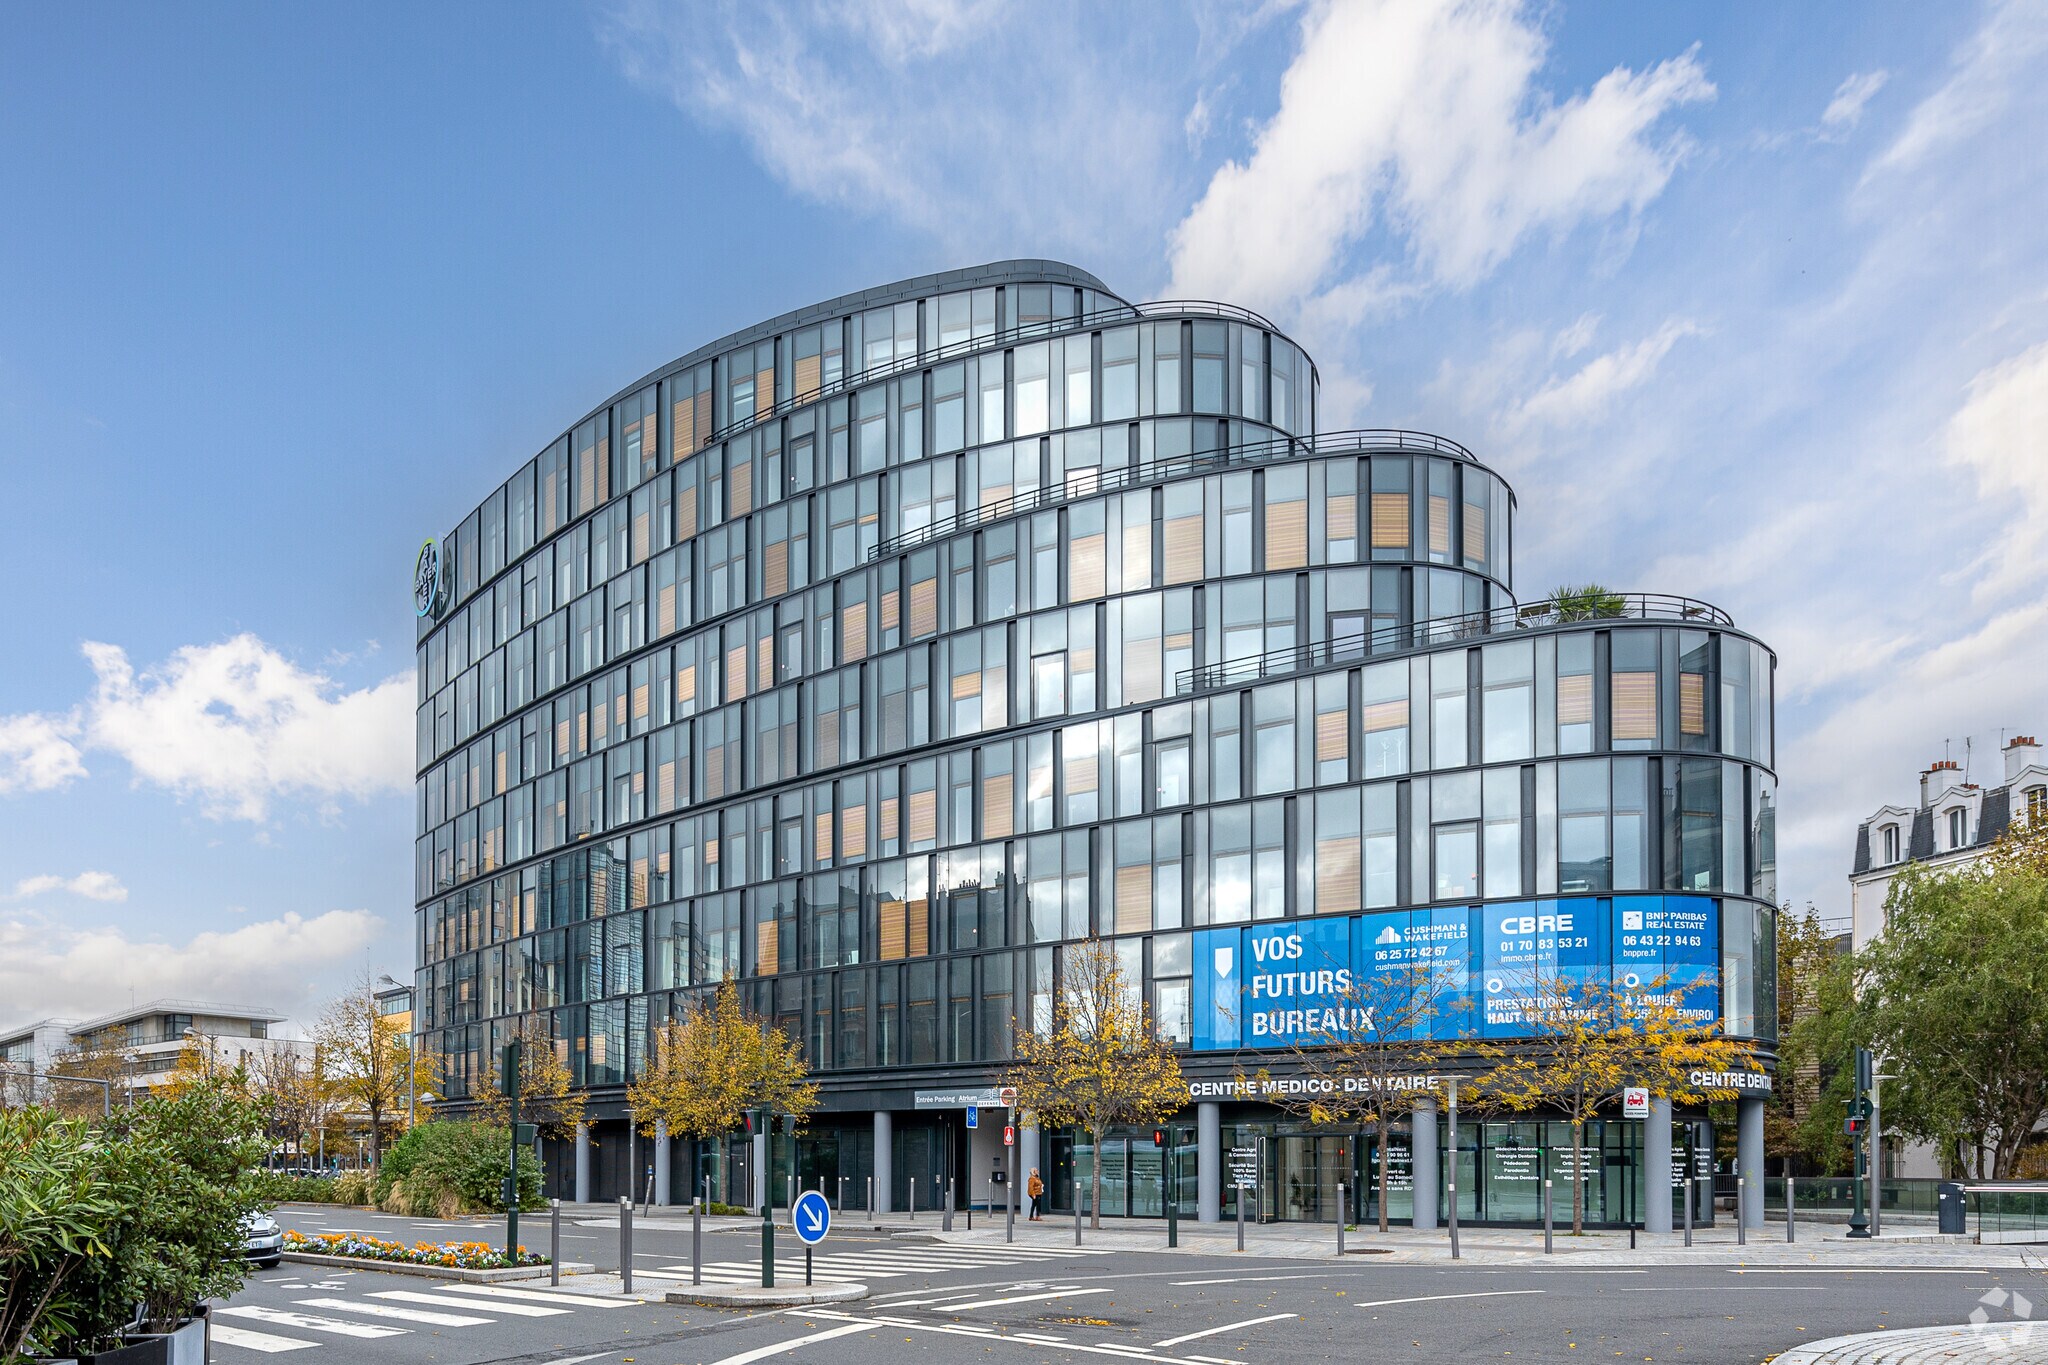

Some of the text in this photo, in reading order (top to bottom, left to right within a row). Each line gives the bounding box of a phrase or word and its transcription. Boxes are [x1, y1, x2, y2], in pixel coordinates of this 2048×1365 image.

[1670, 912, 1707, 921] PARIBAS
[1404, 924, 1457, 934] CUSHMAN
[1500, 914, 1574, 934] CBRE
[1674, 922, 1704, 930] ESTATE
[1404, 932, 1468, 942] WAKEFIELD
[1623, 936, 1701, 946] 06 43 22 94 63
[1252, 934, 1303, 962] VOS
[1501, 937, 1588, 952] 01 70 83 53 21
[1375, 946, 1448, 960] 06 25 72 42 67
[1501, 952, 1552, 962] immo.cbre.fr
[1623, 949, 1656, 958] bnppre.fr
[1253, 968, 1352, 998] FUTURS
[1487, 996, 1572, 1011] PRESTATIONS
[1253, 1006, 1375, 1035] BUREAUX
[1487, 1012, 1521, 1024] HAUT
[1690, 1071, 1746, 1087] CENTRE
[1190, 1082, 1256, 1096] CENTRE
